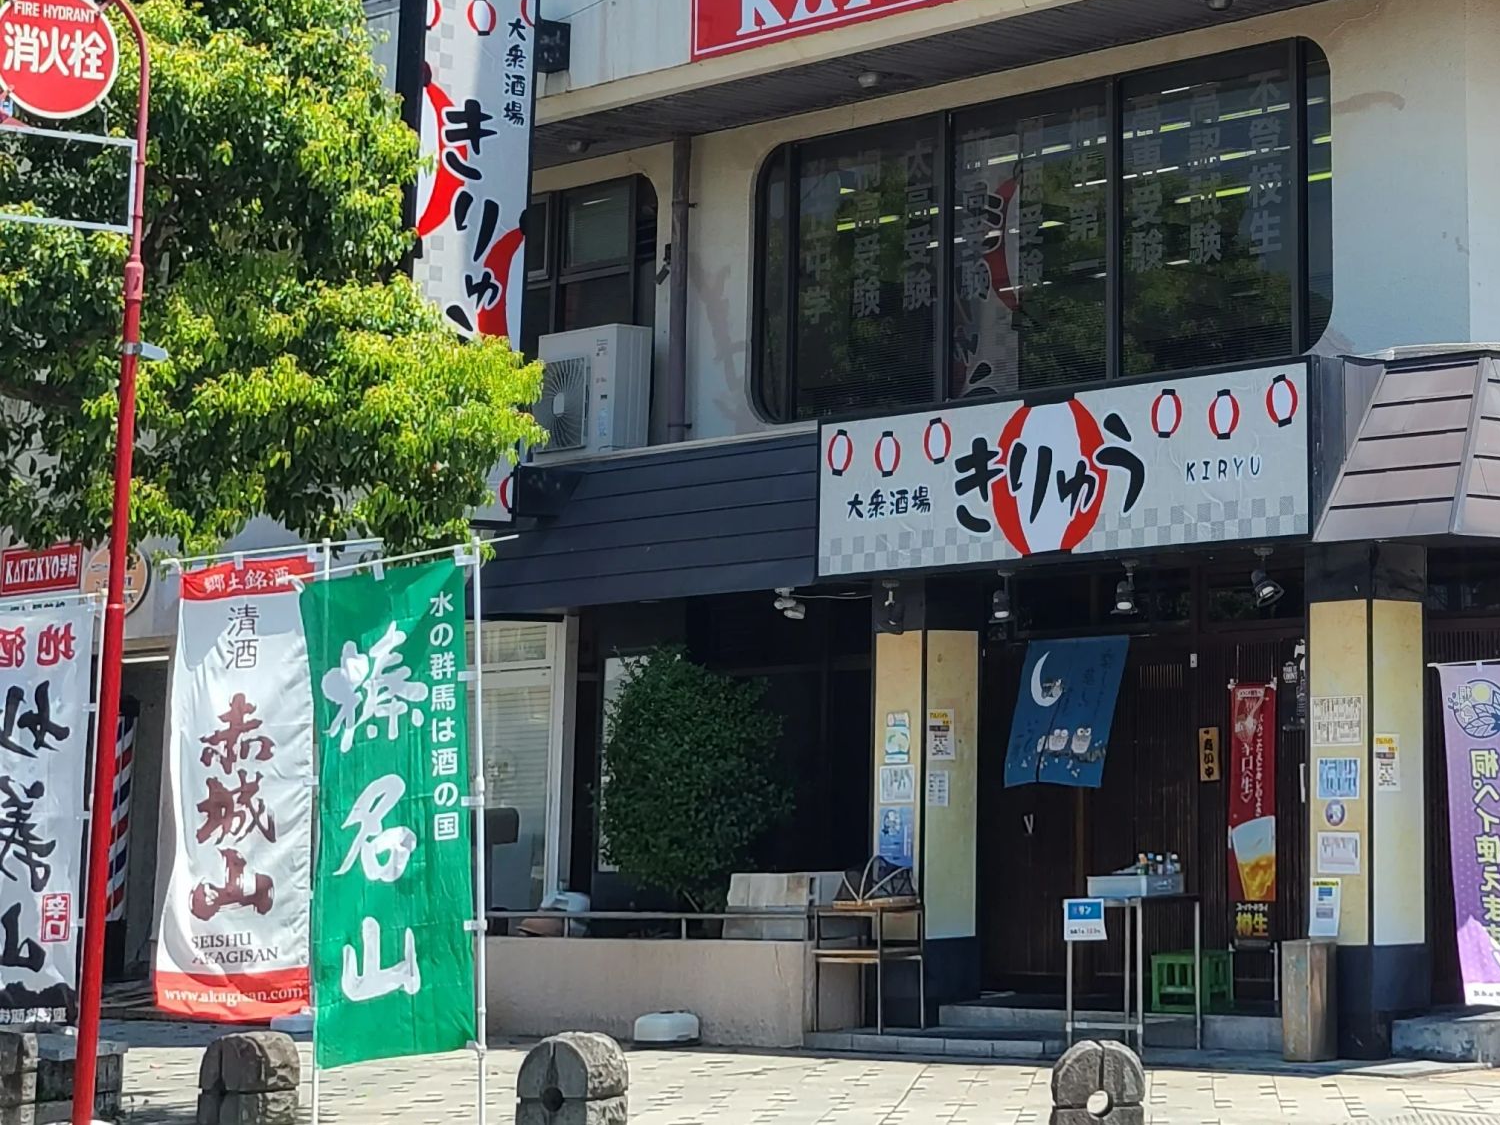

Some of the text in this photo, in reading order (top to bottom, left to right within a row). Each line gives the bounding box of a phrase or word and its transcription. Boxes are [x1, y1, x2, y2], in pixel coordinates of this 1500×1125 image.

[14, 2, 96, 24] FIRE HYDRANT
[3, 21, 107, 80] 消火栓
[503, 17, 528, 127] 大衆酒場
[1248, 72, 1283, 258] 不登校生
[443, 98, 501, 340] きりゅ
[846, 485, 932, 520] 大衆酒場
[955, 413, 1145, 533] きりゅう
[1186, 455, 1262, 483] KIRYU
[5, 553, 78, 585] KATEKYO学院
[225, 603, 260, 671] 清酒
[428, 590, 460, 842] 水の群馬は酒の国
[188, 692, 276, 921] 赤城山
[321, 621, 429, 1002] 榛名山
[192, 931, 252, 949] SEISHU
[192, 947, 279, 965] AKAGISAN
